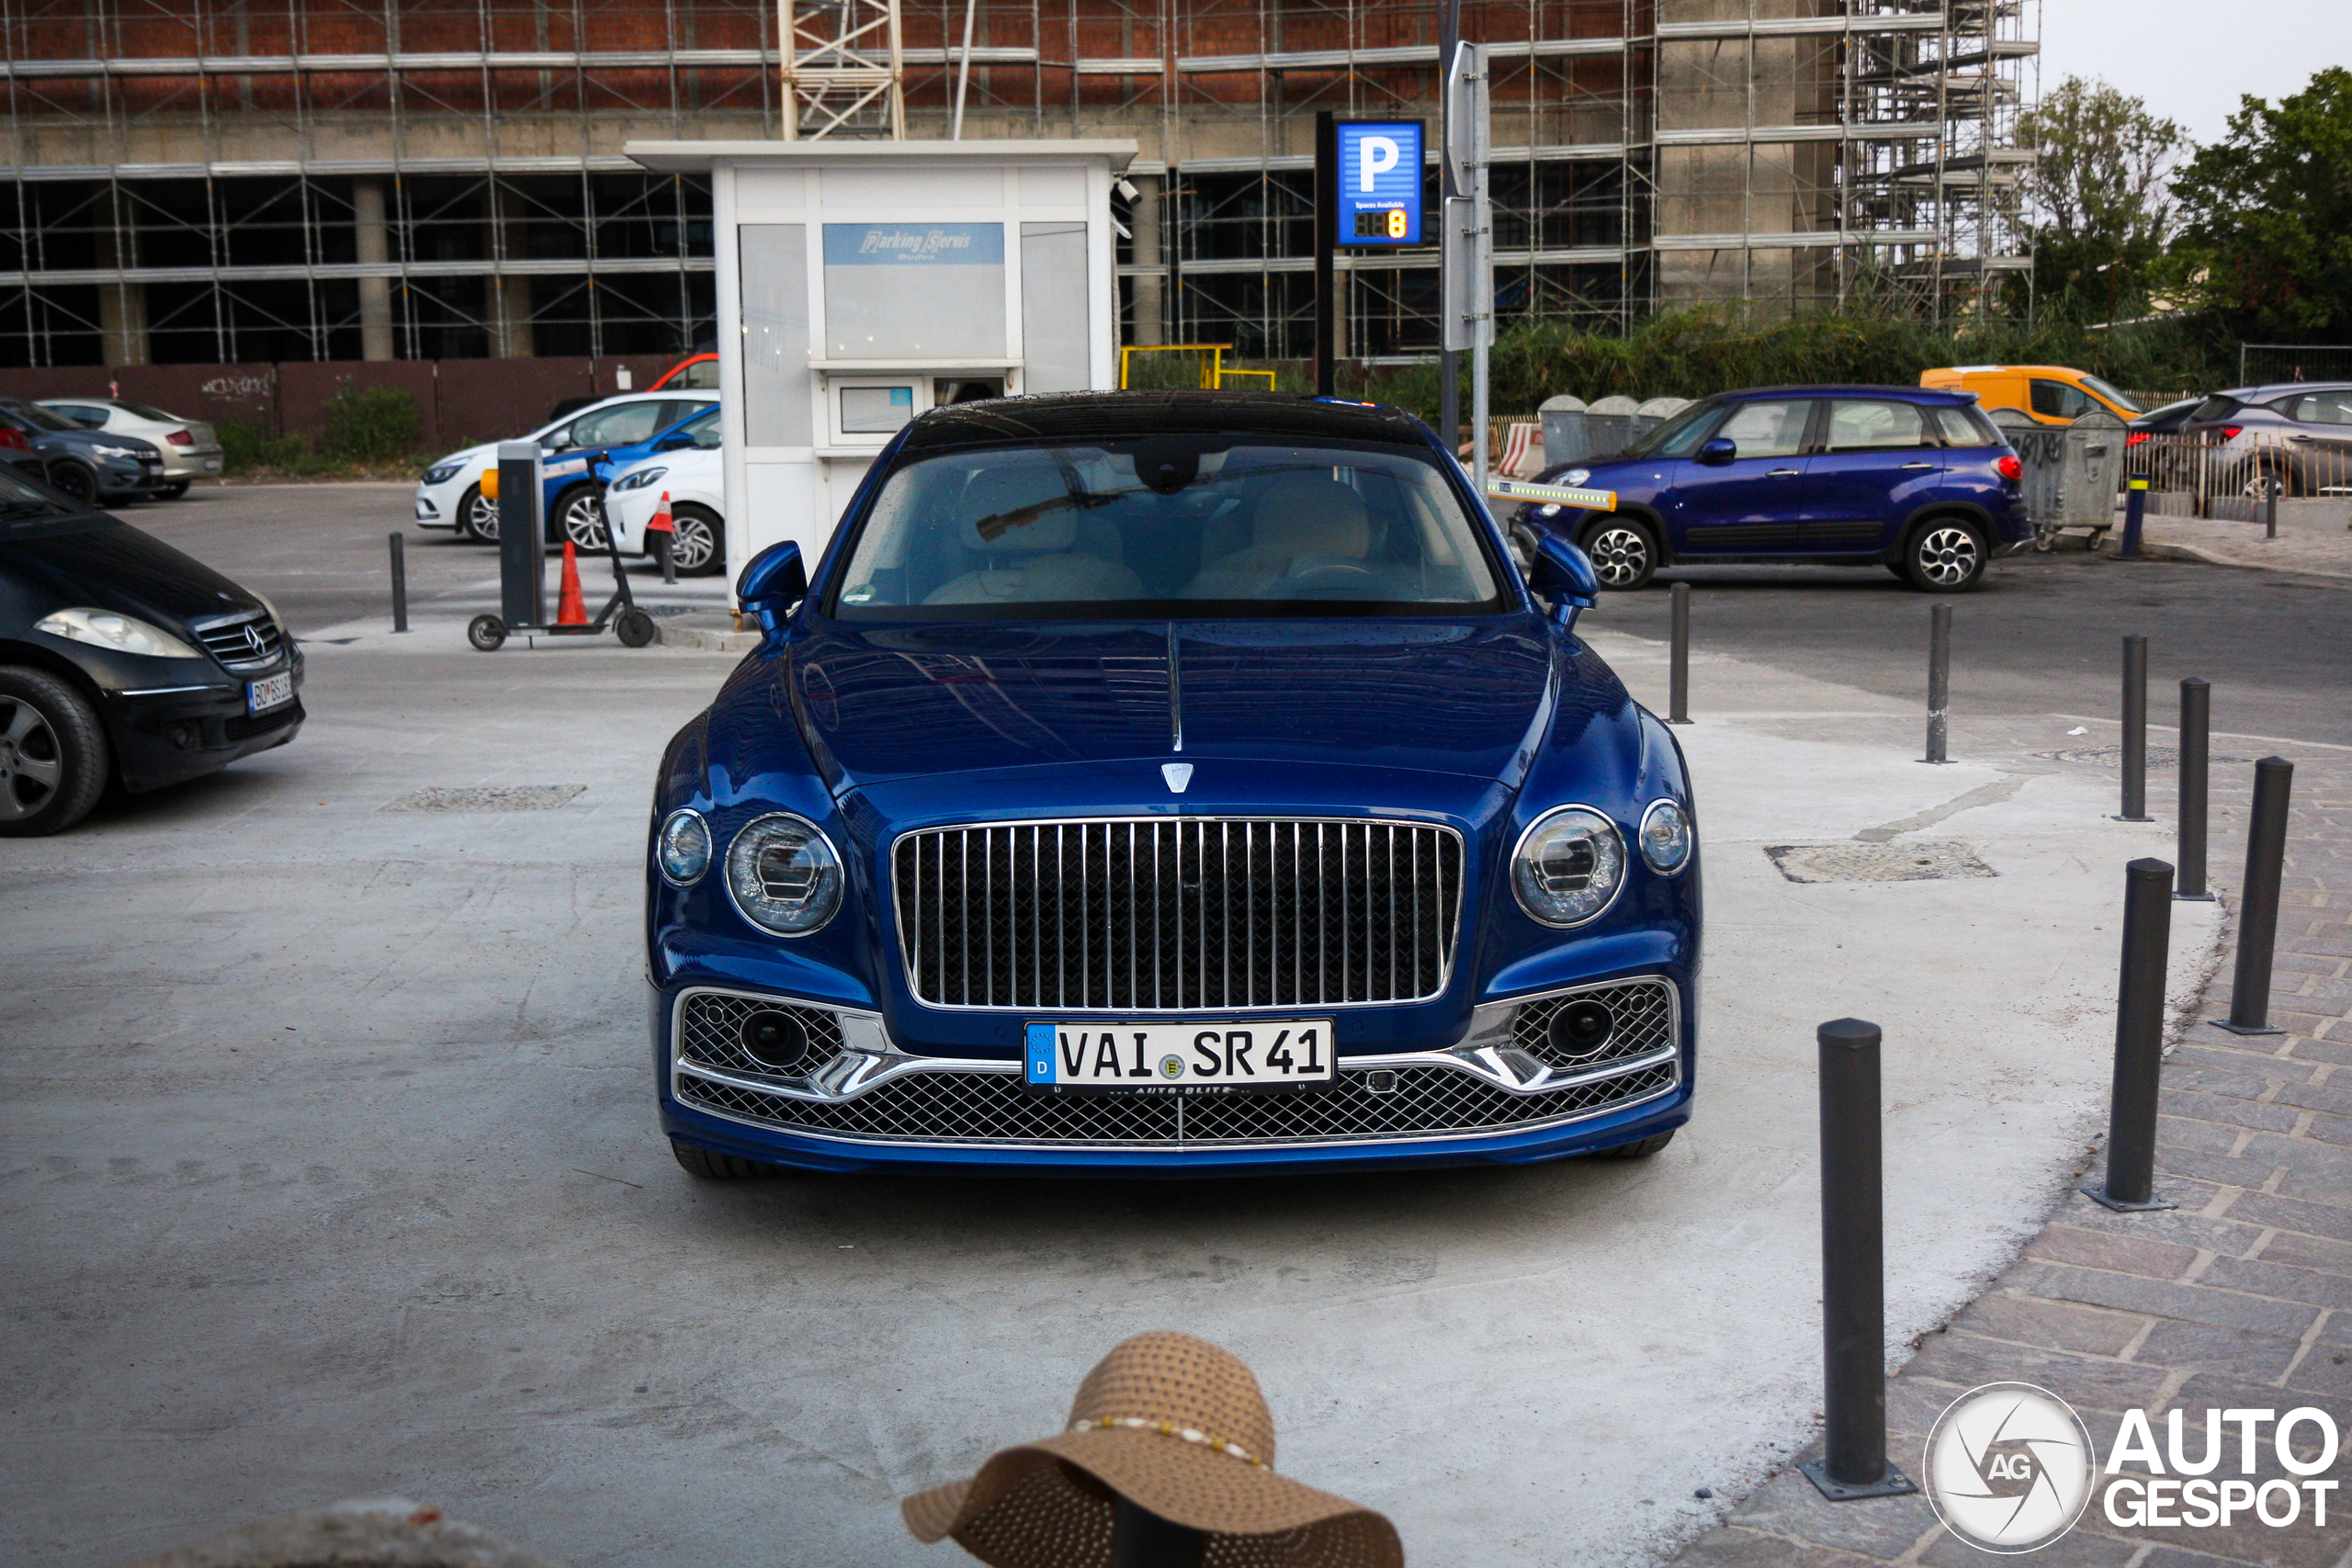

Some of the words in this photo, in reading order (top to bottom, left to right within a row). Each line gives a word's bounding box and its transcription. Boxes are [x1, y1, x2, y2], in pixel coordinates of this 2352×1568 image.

[1361, 136, 1399, 192] P
[1355, 202, 1376, 210] Spaces
[1388, 209, 1407, 238] 8
[859, 231, 923, 254] Parking
[921, 231, 972, 254] Servis
[1036, 1061, 1047, 1074] D
[1059, 1032, 1152, 1077] VAI
[1193, 1031, 1255, 1077] SR
[1266, 1029, 1325, 1075] 41
